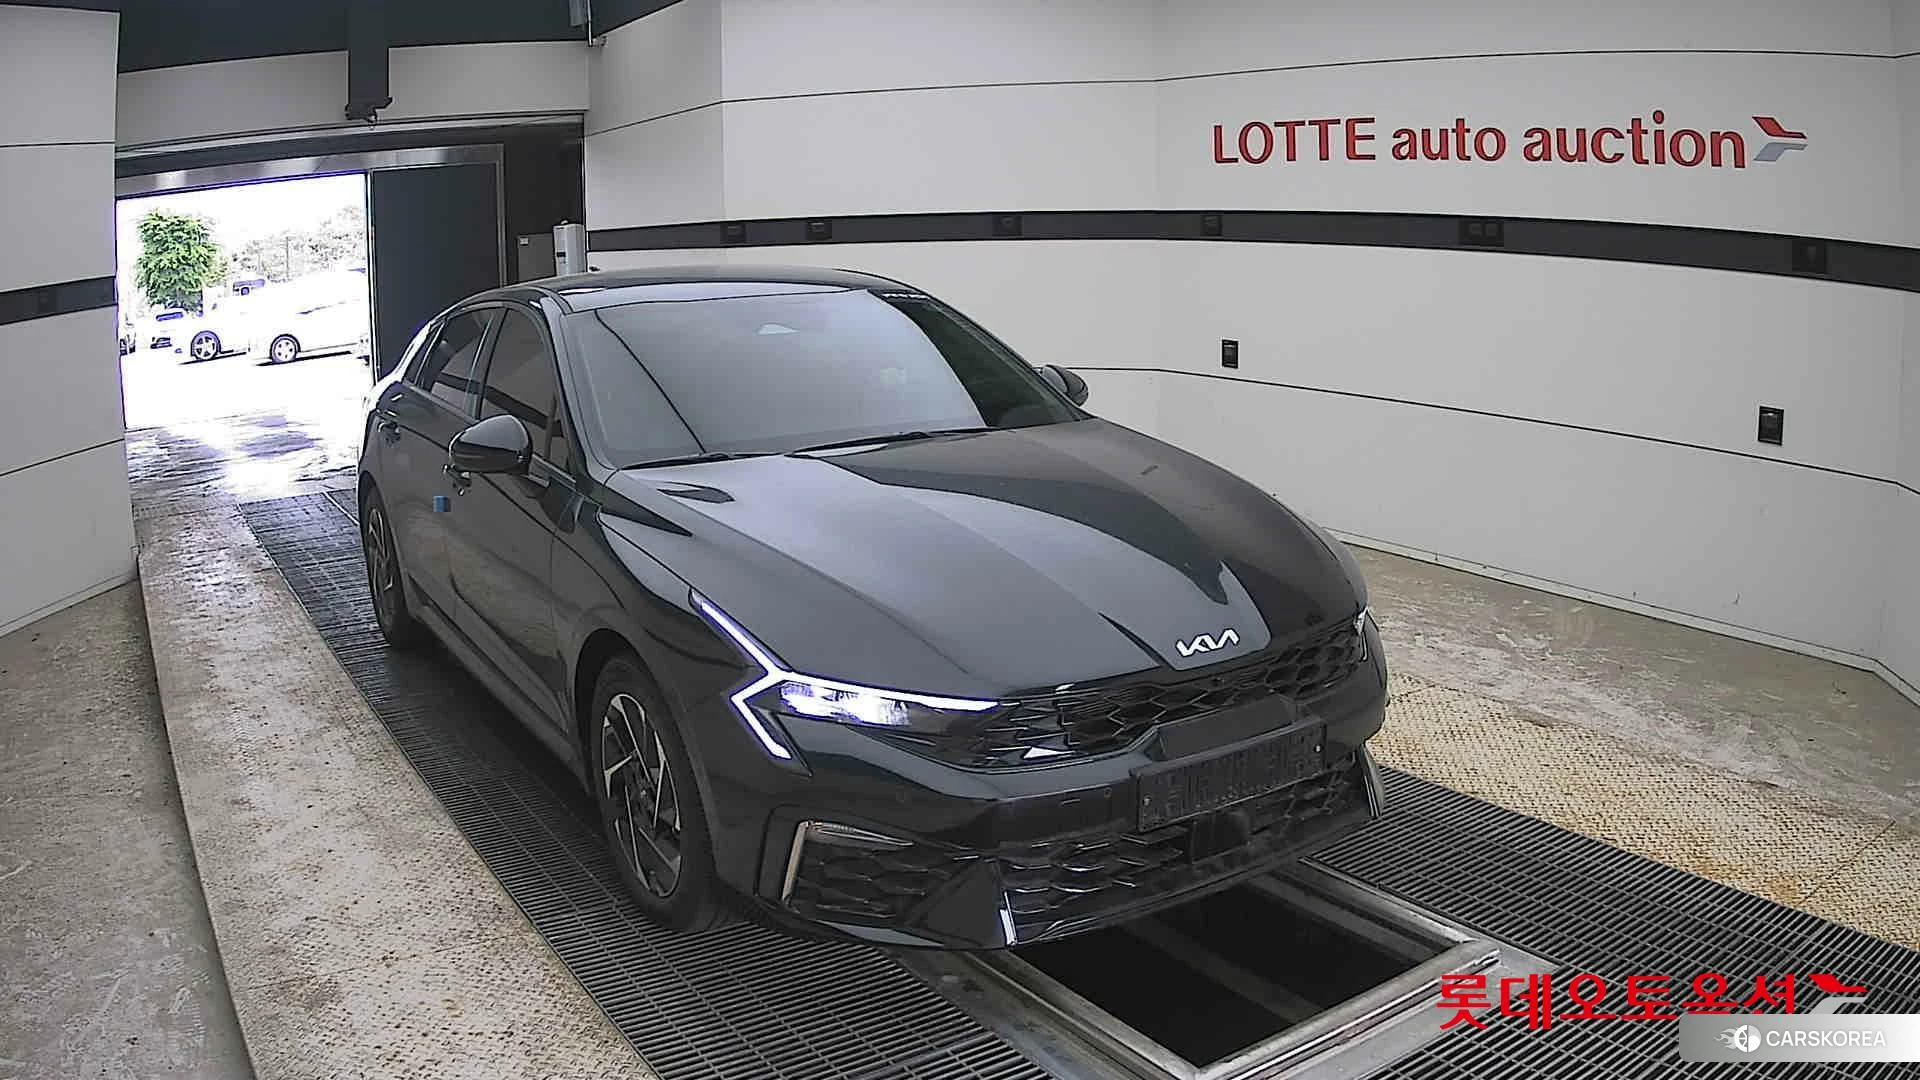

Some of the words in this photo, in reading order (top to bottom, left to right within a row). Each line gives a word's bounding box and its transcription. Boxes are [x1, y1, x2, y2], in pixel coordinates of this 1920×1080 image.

[1213, 117, 1377, 164] LOTTE
[1391, 118, 1507, 162] auto
[1523, 110, 1746, 168] auction
